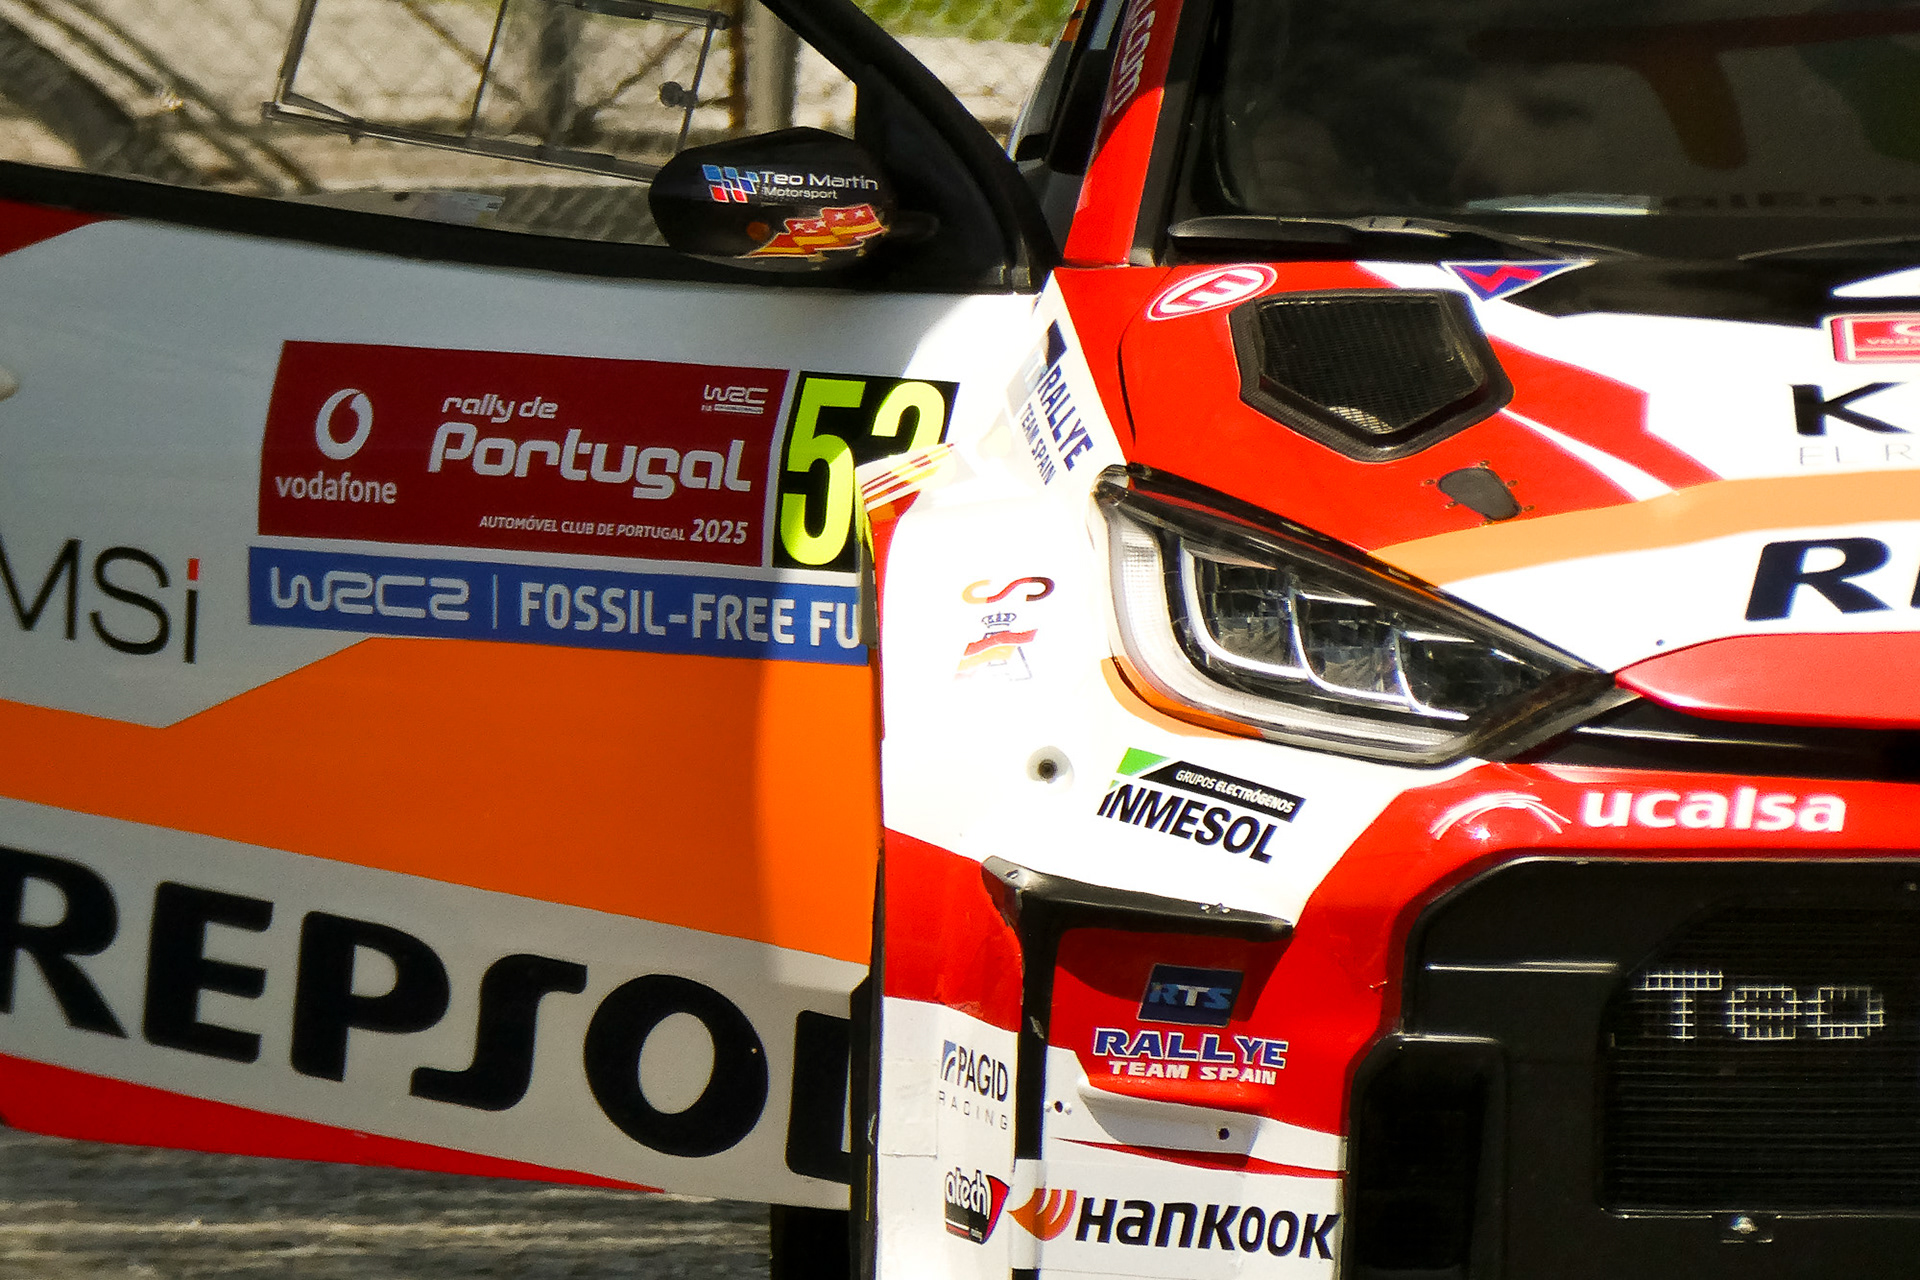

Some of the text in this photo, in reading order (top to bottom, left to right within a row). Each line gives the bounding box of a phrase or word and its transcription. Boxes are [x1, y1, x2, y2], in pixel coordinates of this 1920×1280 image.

[760, 171, 804, 185] Teo
[762, 187, 838, 199] Motorsport
[442, 393, 559, 423] rally de
[703, 384, 769, 404] WRC
[1038, 364, 1093, 471] RALLYE
[427, 421, 752, 500] Portugal
[1020, 402, 1057, 485] TEAM SPAIN
[275, 471, 397, 504] vodafone
[479, 515, 749, 545] AUTOMÓVEL CLUB DE PORTUGAL 2025
[1744, 536, 1920, 622] R
[270, 566, 470, 621] WRC2
[519, 582, 795, 644] FOSSIL-FREE
[1176, 769, 1295, 813] GRUPOS ELECTRÓGENOS
[1581, 786, 1847, 833] ucalsa
[1150, 982, 1233, 1009] RTS
[1093, 1027, 1289, 1069] RALLYE
[957, 1046, 1009, 1102] PAGID
[1108, 1060, 1278, 1085] TEAM SPAIN
[938, 1090, 1008, 1130] RACING
[945, 1167, 988, 1216] atech
